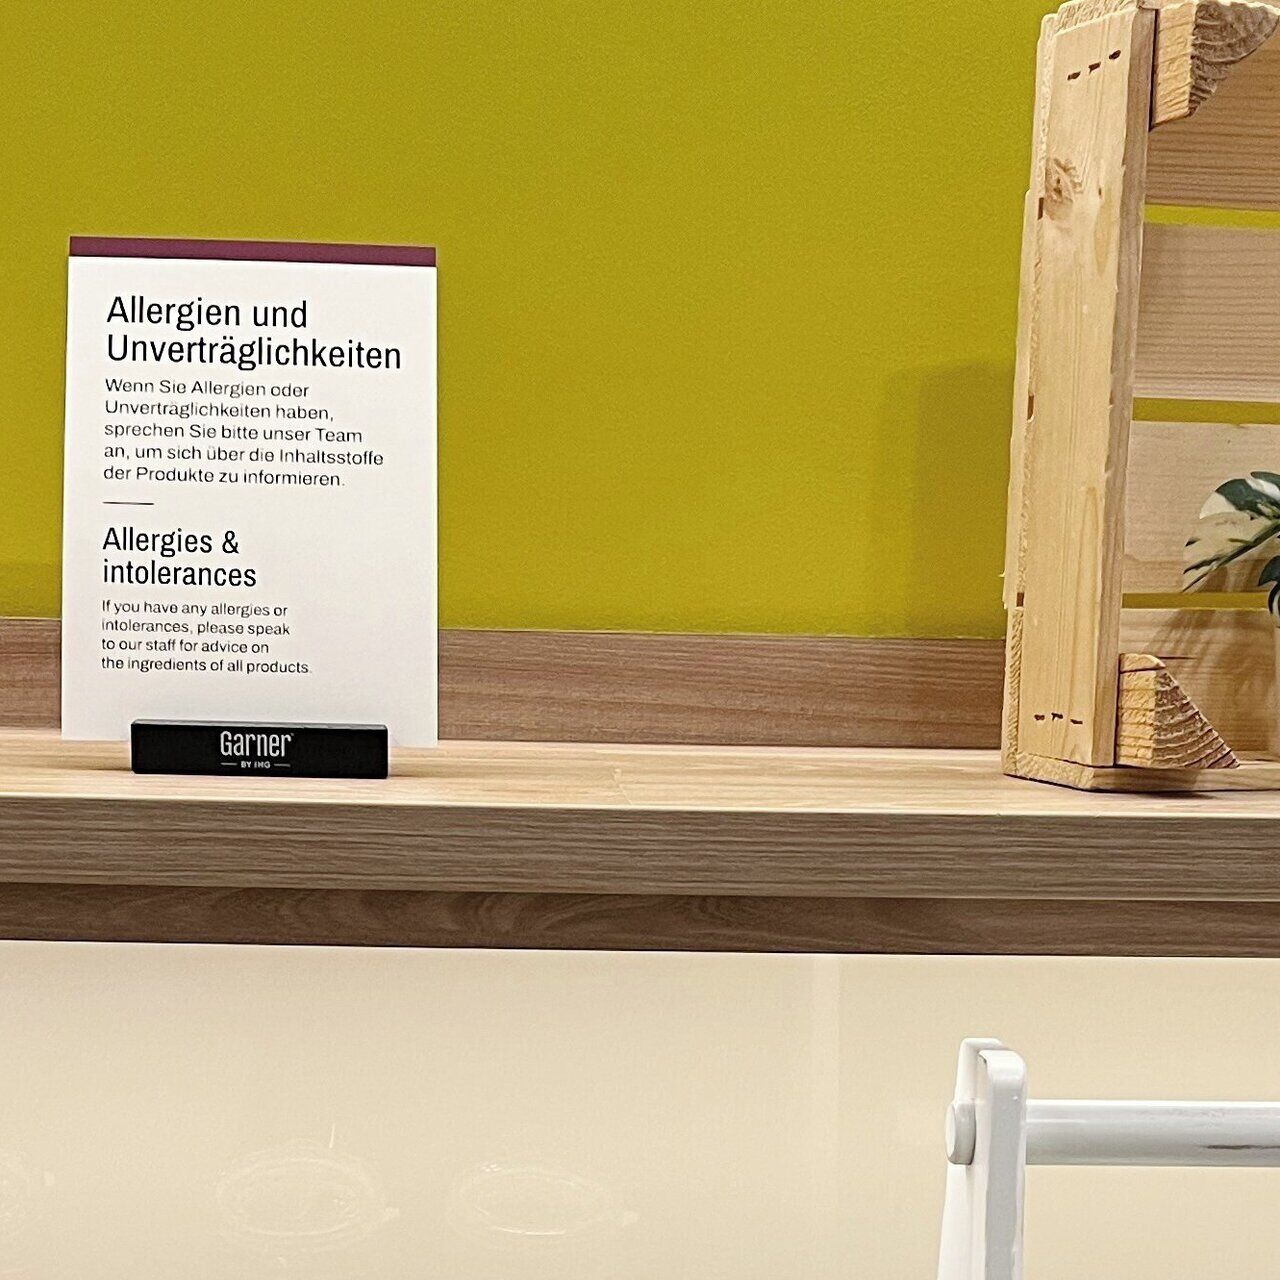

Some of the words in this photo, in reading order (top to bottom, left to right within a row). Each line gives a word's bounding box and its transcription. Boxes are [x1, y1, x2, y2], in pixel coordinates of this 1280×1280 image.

[106, 295, 240, 332] Allergien
[253, 299, 307, 329] und
[108, 333, 401, 371] Unverträglichkeiten
[105, 378, 154, 393] Wenn
[159, 379, 187, 394] Sie
[190, 380, 266, 399] Allergien
[270, 383, 309, 398] oder
[105, 400, 271, 419] Unverträglichkeiten
[276, 404, 334, 422] haben,
[104, 423, 185, 438] sprechen
[189, 424, 217, 439] Sie
[221, 424, 259, 440] bitte
[263, 429, 311, 441] unser
[314, 427, 362, 443] Team
[104, 446, 130, 460] an,
[135, 447, 163, 459] um
[167, 445, 202, 460] sich
[206, 446, 245, 462] über
[249, 447, 275, 463] die
[280, 448, 384, 466] Inhaltsstoffe
[103, 465, 132, 480] der
[136, 466, 215, 483] Produkte
[218, 472, 239, 484] zu
[243, 469, 345, 486] informieren.
[102, 526, 213, 558] Allergies
[221, 530, 240, 554] &
[103, 558, 257, 588] intolerances
[102, 599, 111, 612] If
[113, 602, 140, 615] you
[143, 601, 178, 614] have
[181, 604, 208, 617] any
[210, 602, 271, 619] allergies
[273, 606, 288, 617] or
[101, 618, 193, 635] intolerances,
[197, 621, 244, 636] please
[247, 623, 290, 637] speak
[101, 638, 116, 650] to
[118, 640, 143, 651] our
[145, 638, 176, 652] staff
[179, 638, 199, 652] for
[201, 640, 248, 654] advice
[251, 643, 269, 654] on
[101, 656, 124, 670] the
[127, 658, 207, 673] ingredients
[210, 659, 224, 672] of
[226, 659, 243, 672] all
[246, 660, 313, 675] products.
[220, 730, 292, 757] Garner
[240, 760, 252, 769] BY
